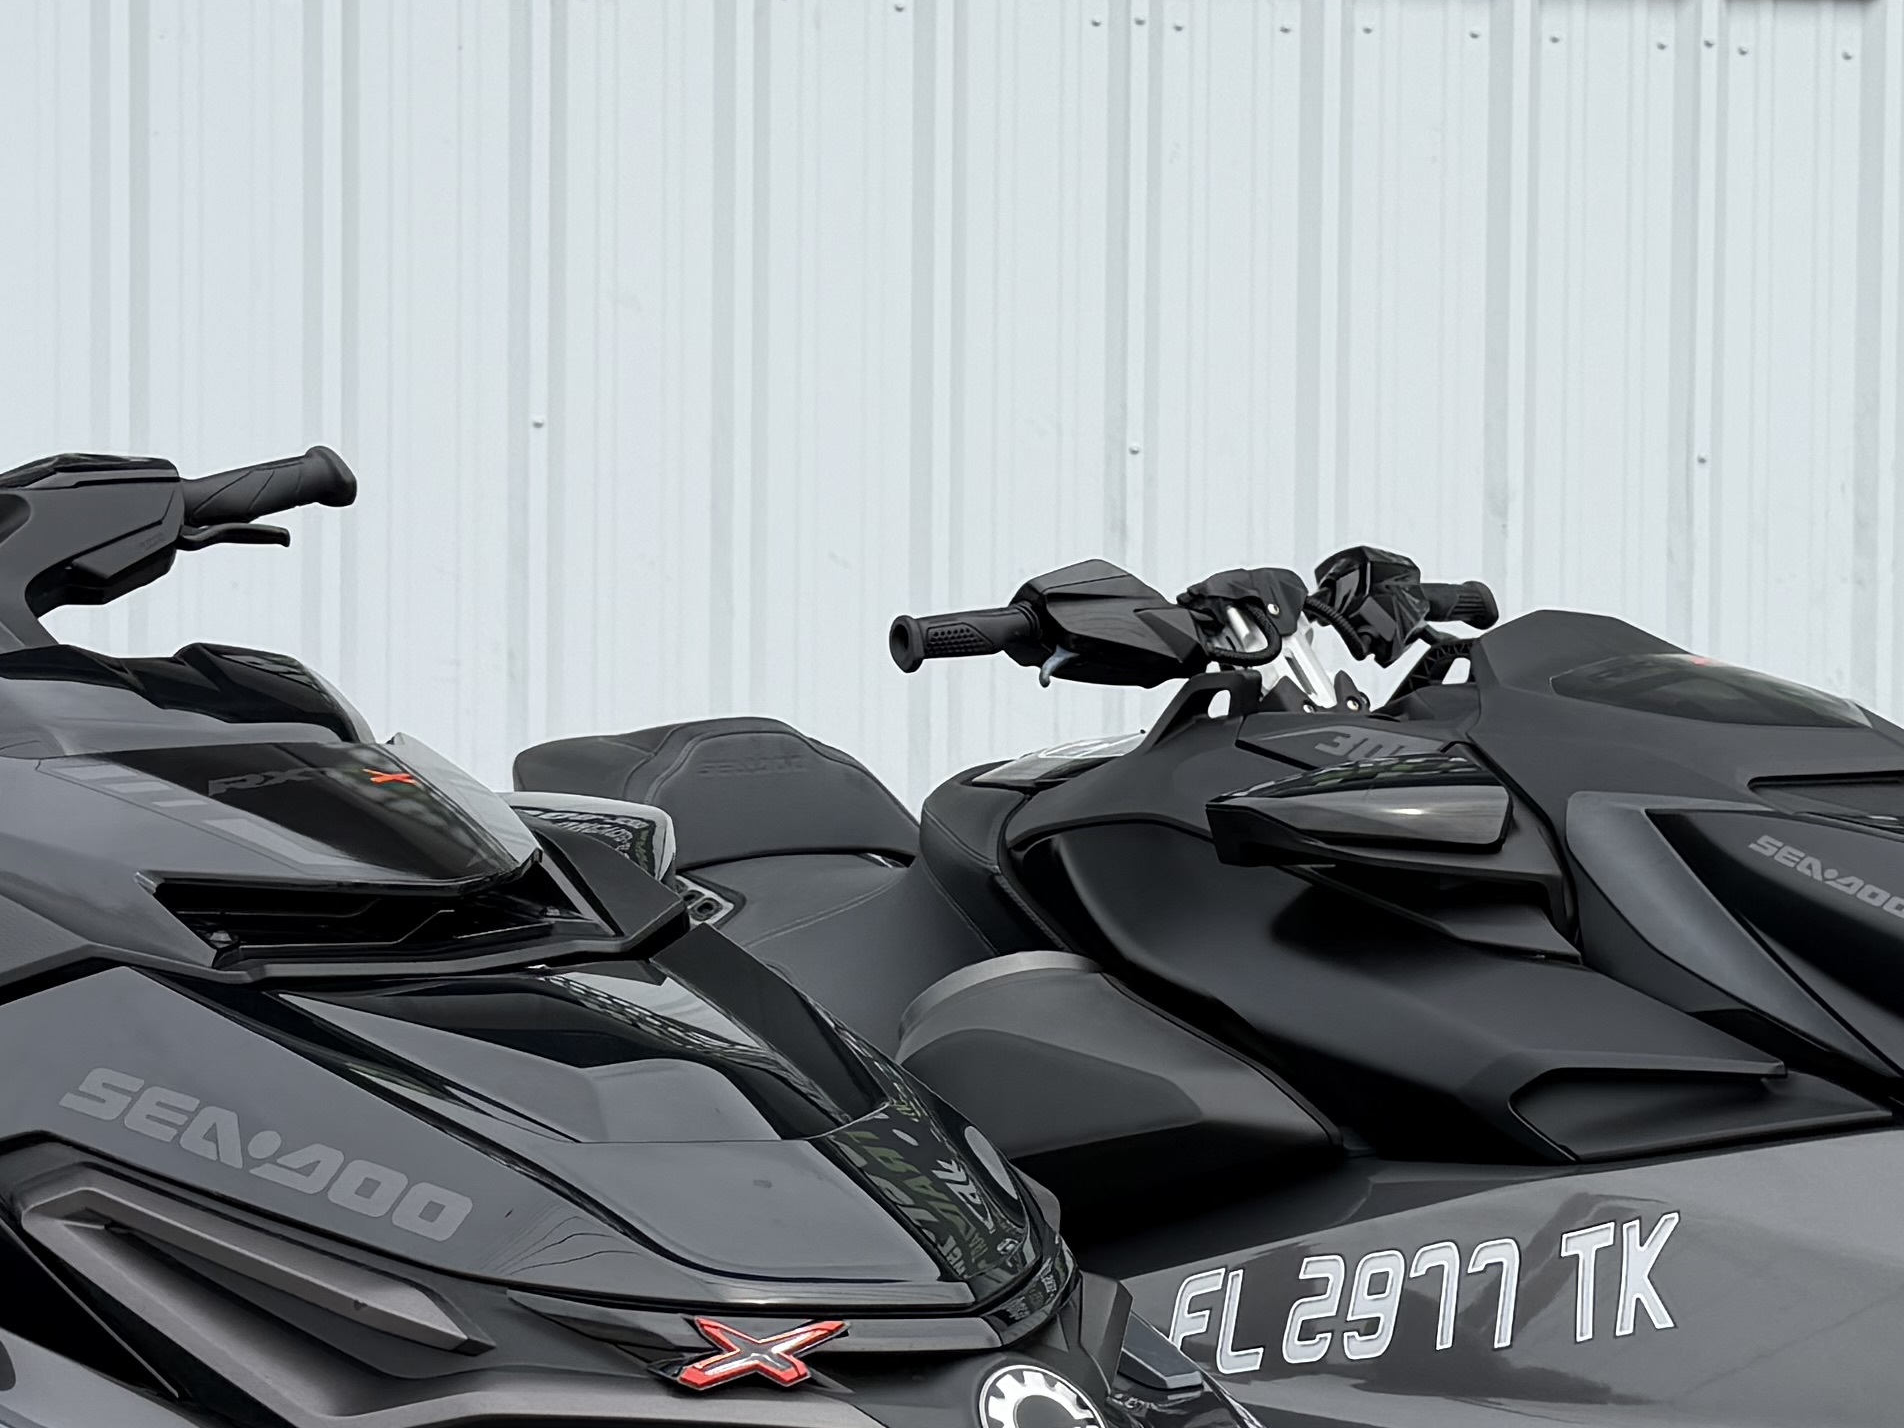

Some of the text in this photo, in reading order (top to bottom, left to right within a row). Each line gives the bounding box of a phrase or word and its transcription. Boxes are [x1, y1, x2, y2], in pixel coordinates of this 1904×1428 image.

[1168, 1267, 1265, 1375] FL
[1281, 1237, 1521, 1364] 2977
[1559, 1211, 1681, 1344] TK
